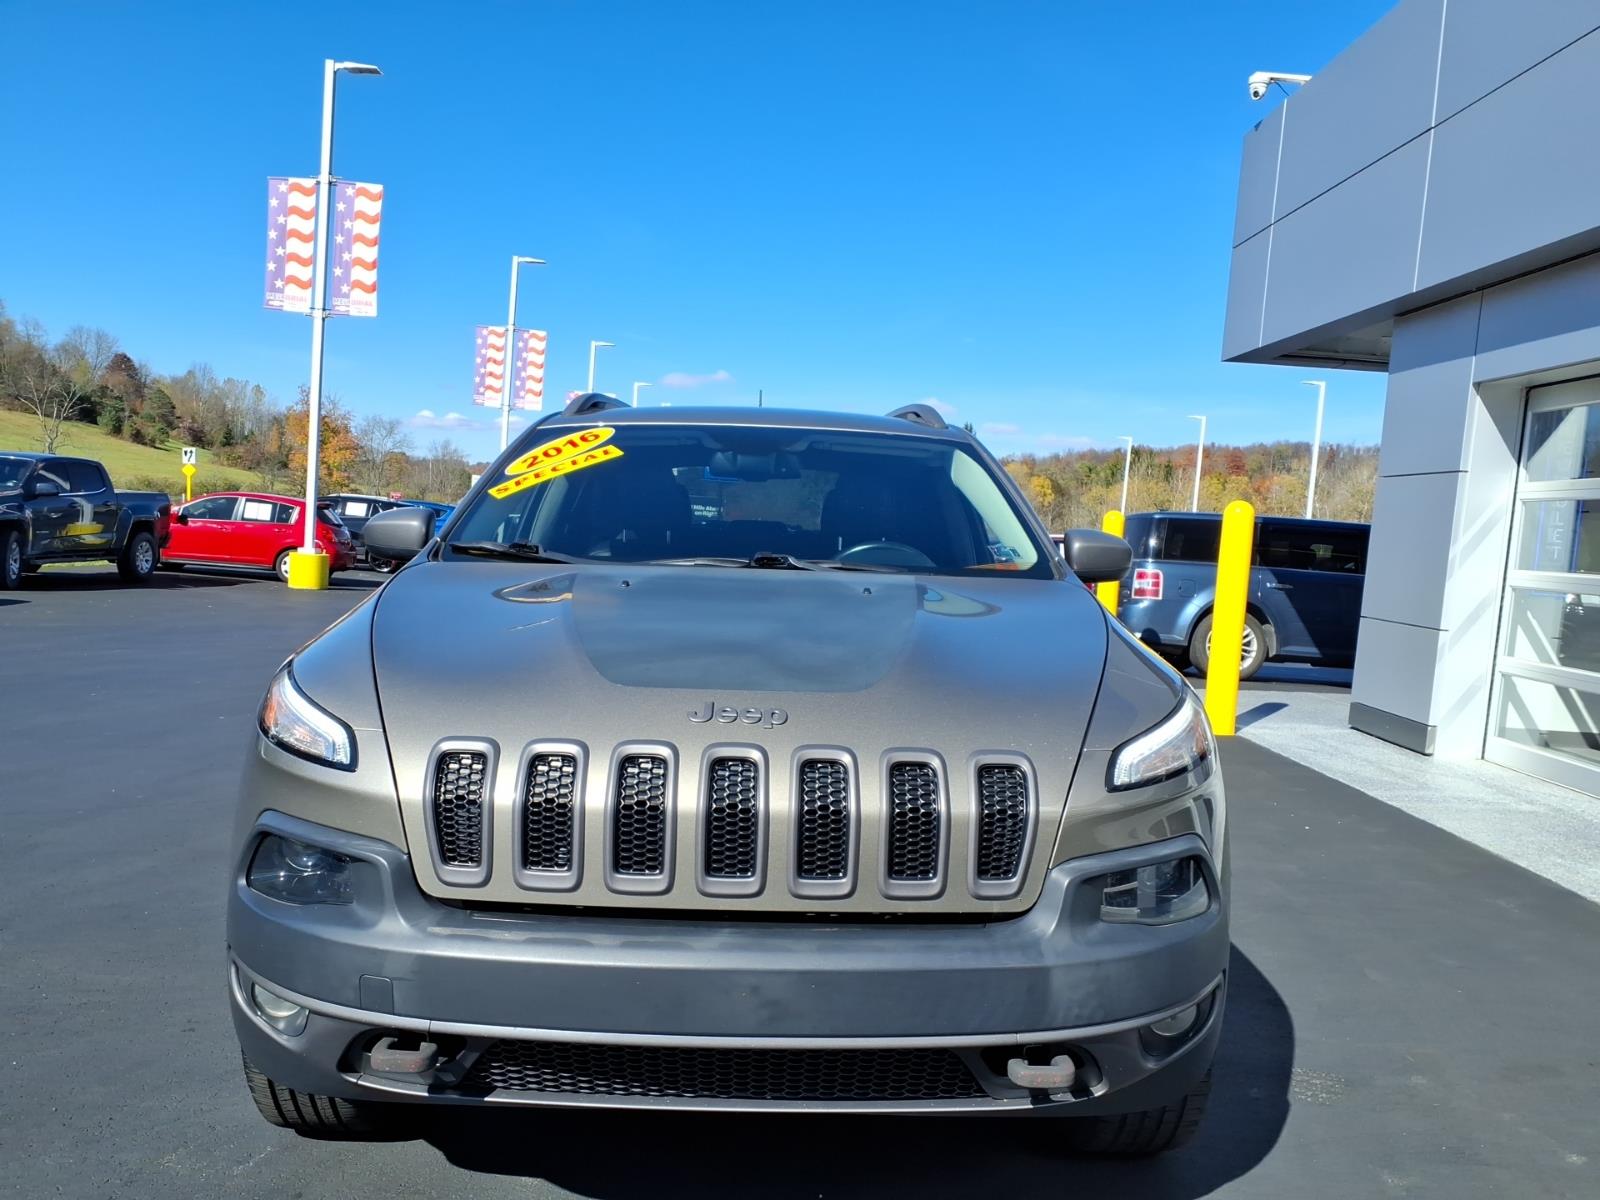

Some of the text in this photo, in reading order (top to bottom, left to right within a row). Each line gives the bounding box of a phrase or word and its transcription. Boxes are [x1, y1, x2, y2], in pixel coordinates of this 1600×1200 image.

[521, 432, 600, 468] 2016
[496, 449, 613, 494] SPECIAL
[687, 701, 788, 729] Jeep
